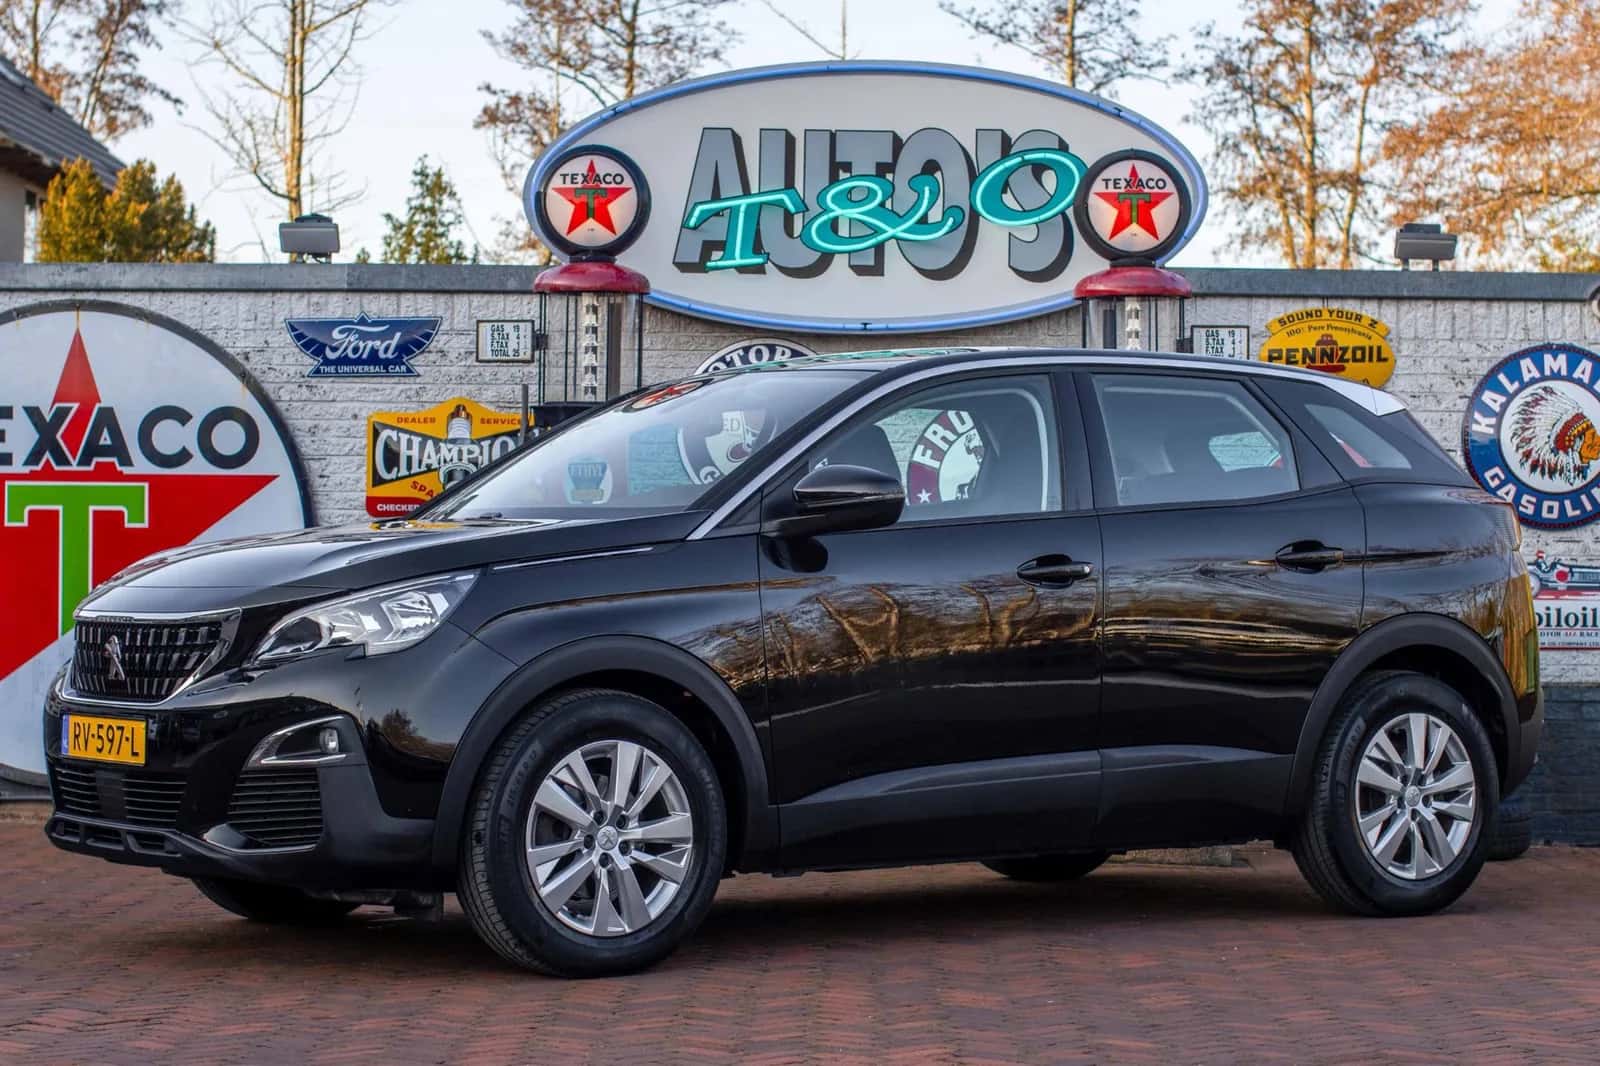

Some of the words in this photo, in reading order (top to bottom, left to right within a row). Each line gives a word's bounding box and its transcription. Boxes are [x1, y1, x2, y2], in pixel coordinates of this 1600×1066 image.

[560, 173, 624, 185] TEXACO
[1102, 178, 1167, 189] TEXACO
[672, 127, 1073, 281] AUTO'S
[1278, 309, 1323, 327] SOUND
[1327, 308, 1363, 323] YOUR
[1367, 319, 1379, 329] Z
[490, 324, 505, 332] GAS
[1205, 329, 1220, 337] GAS
[1307, 323, 1326, 332] Pure
[1326, 323, 1373, 340] Pennsylvania
[325, 324, 402, 359] Ford
[490, 349, 510, 357] TOTAL
[1267, 345, 1390, 365] PENNZOIL
[320, 365, 336, 373] THE
[338, 365, 385, 373] UNIVERSAL
[388, 364, 407, 373] CAR
[1472, 354, 1600, 435] KALAMA
[480, 417, 522, 425] SERVIC
[375, 428, 540, 480] CHAMPIO
[73, 720, 140, 757] RV-597-L
